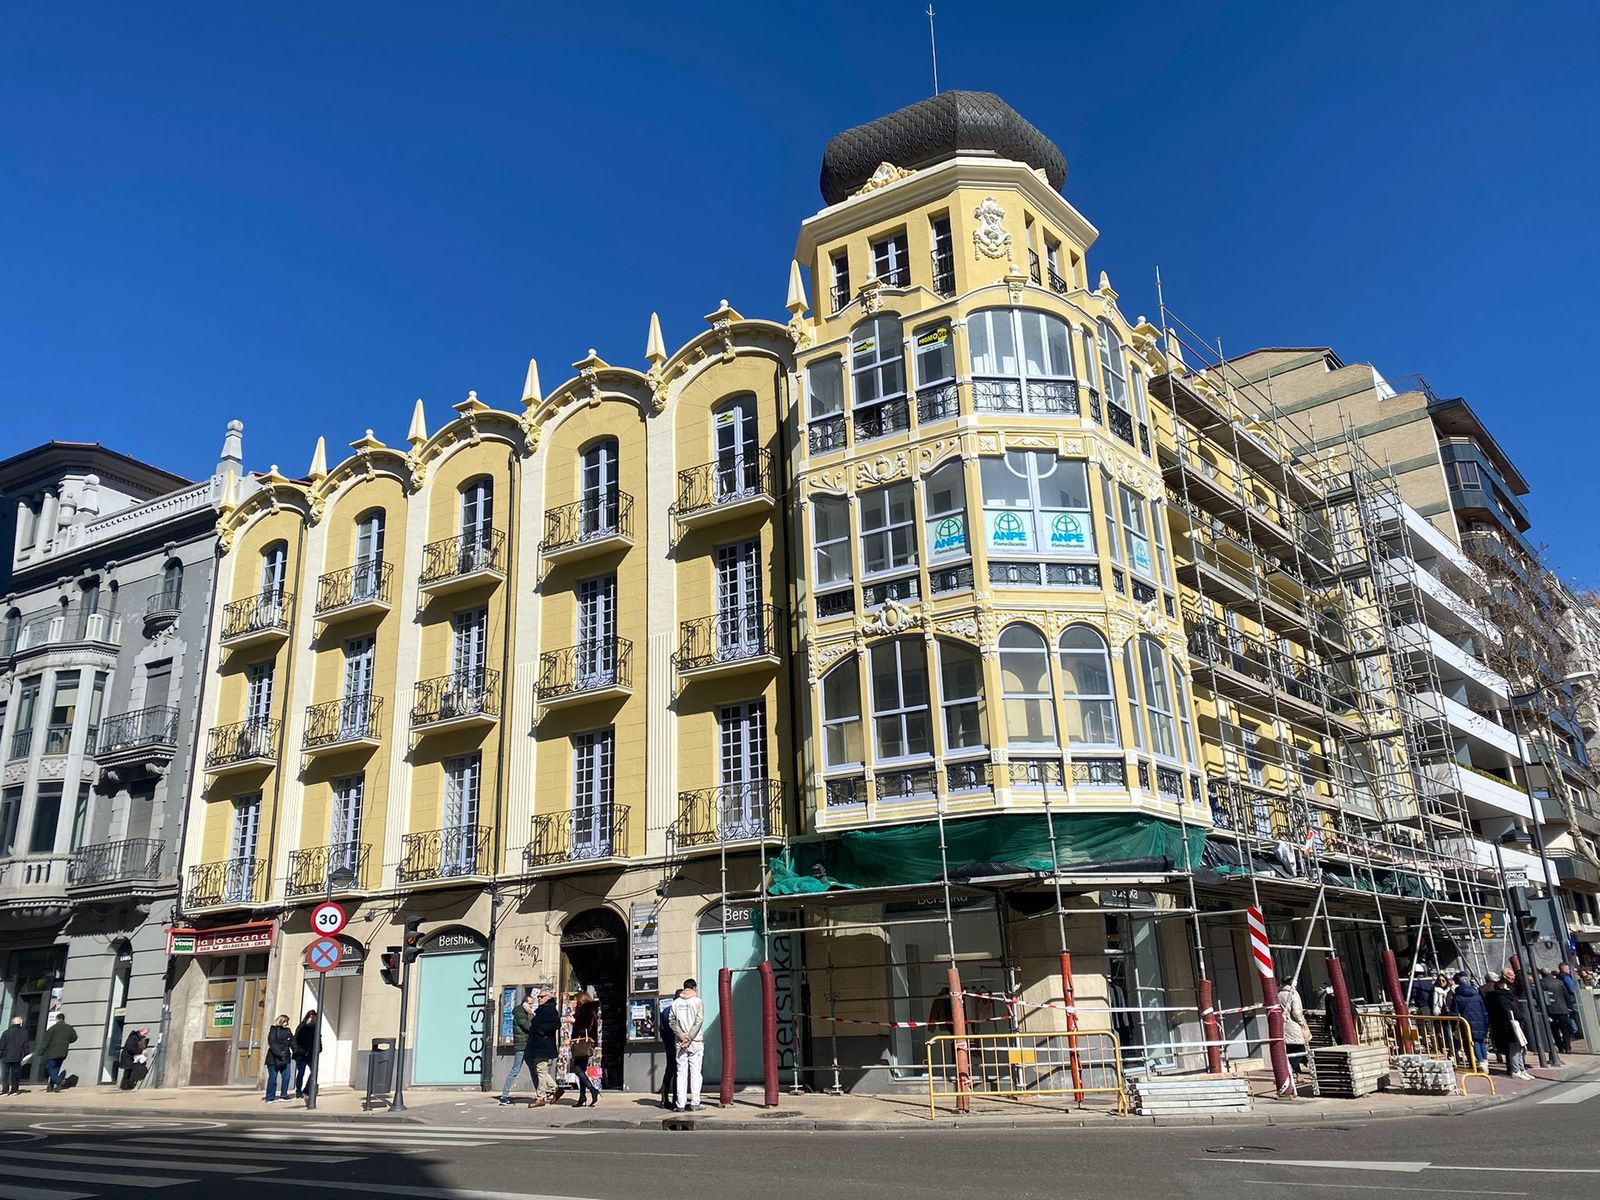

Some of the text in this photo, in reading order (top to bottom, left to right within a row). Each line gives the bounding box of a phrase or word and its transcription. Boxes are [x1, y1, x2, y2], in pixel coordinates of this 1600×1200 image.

[934, 534, 966, 549] ANPE
[993, 531, 1027, 541] ANPE
[1051, 532, 1085, 542] ANPE
[319, 914, 338, 925] 30
[724, 907, 754, 922] Bers
[439, 935, 475, 947] Bershka
[463, 959, 488, 1075] Bershka
